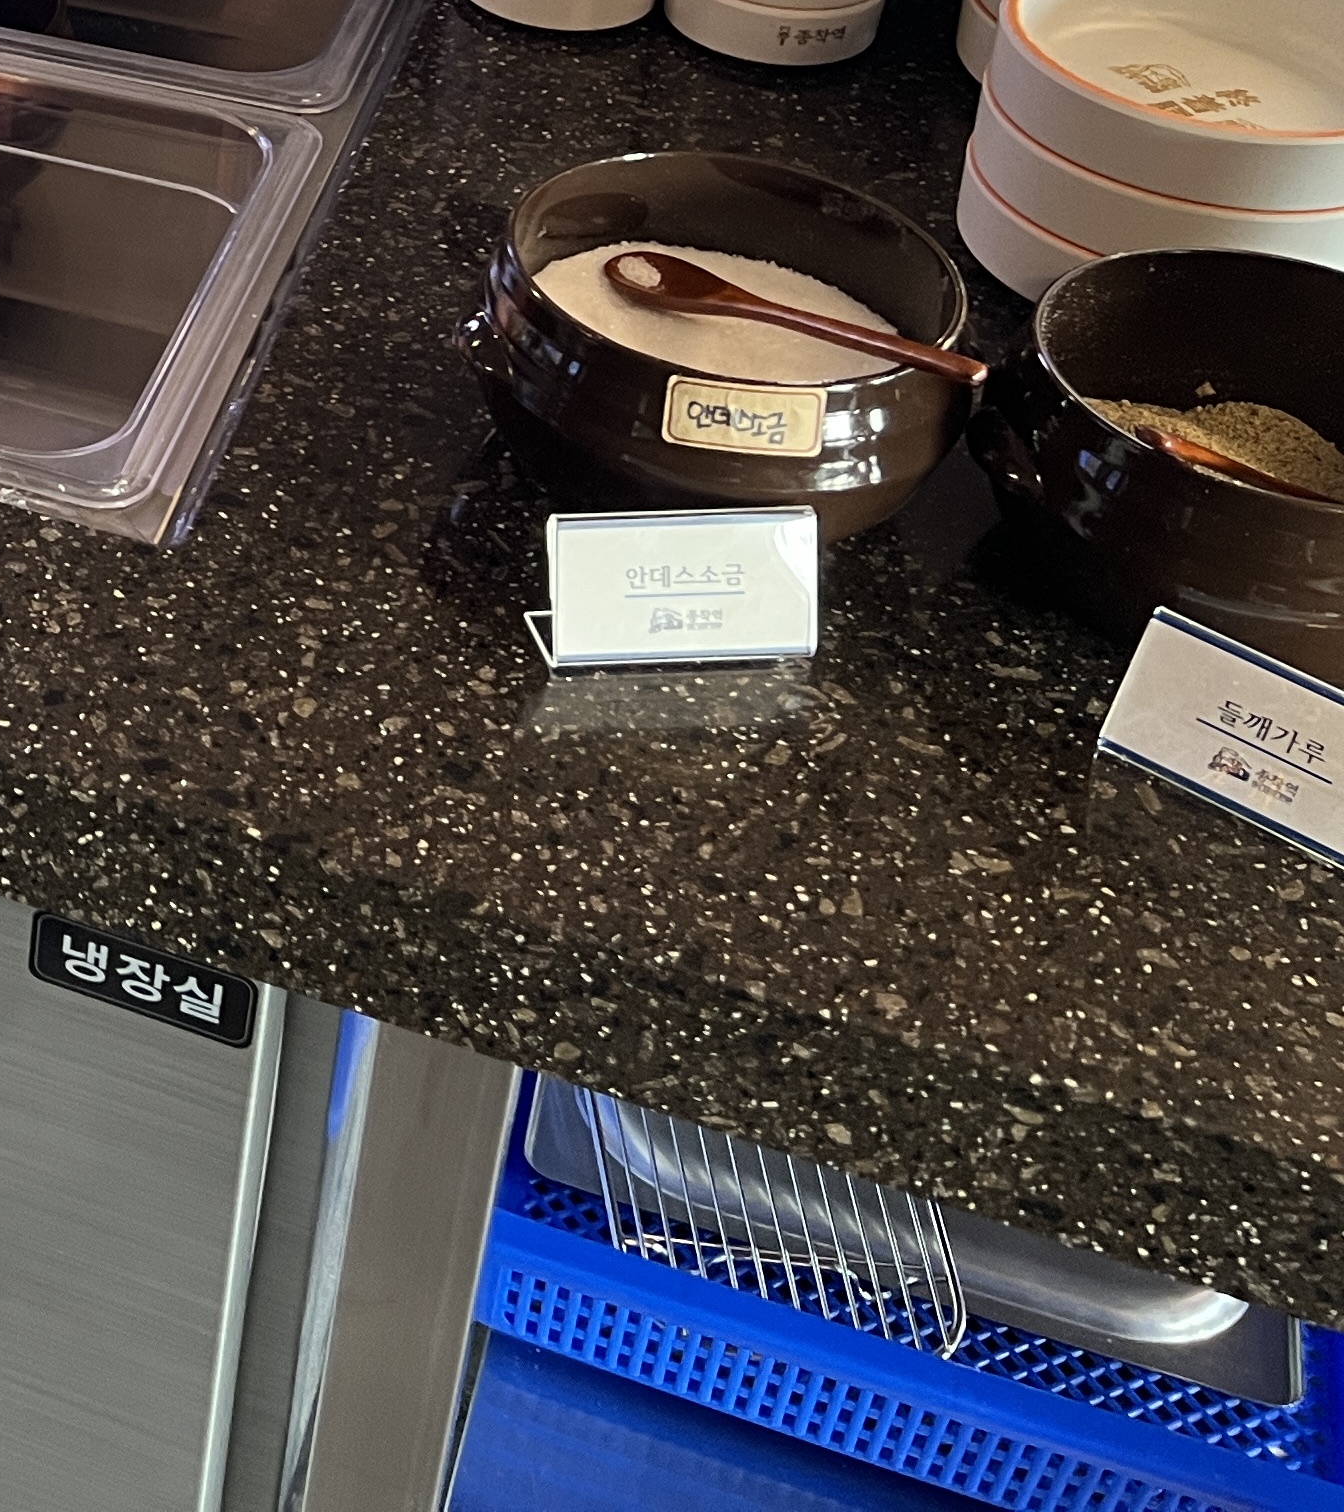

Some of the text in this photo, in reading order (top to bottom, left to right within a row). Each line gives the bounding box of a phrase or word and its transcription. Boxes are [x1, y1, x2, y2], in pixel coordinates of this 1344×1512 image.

[625, 563, 745, 589] 안데스소금
[1217, 700, 1326, 764] 들깨가루
[62, 934, 223, 1024] 냉장실
